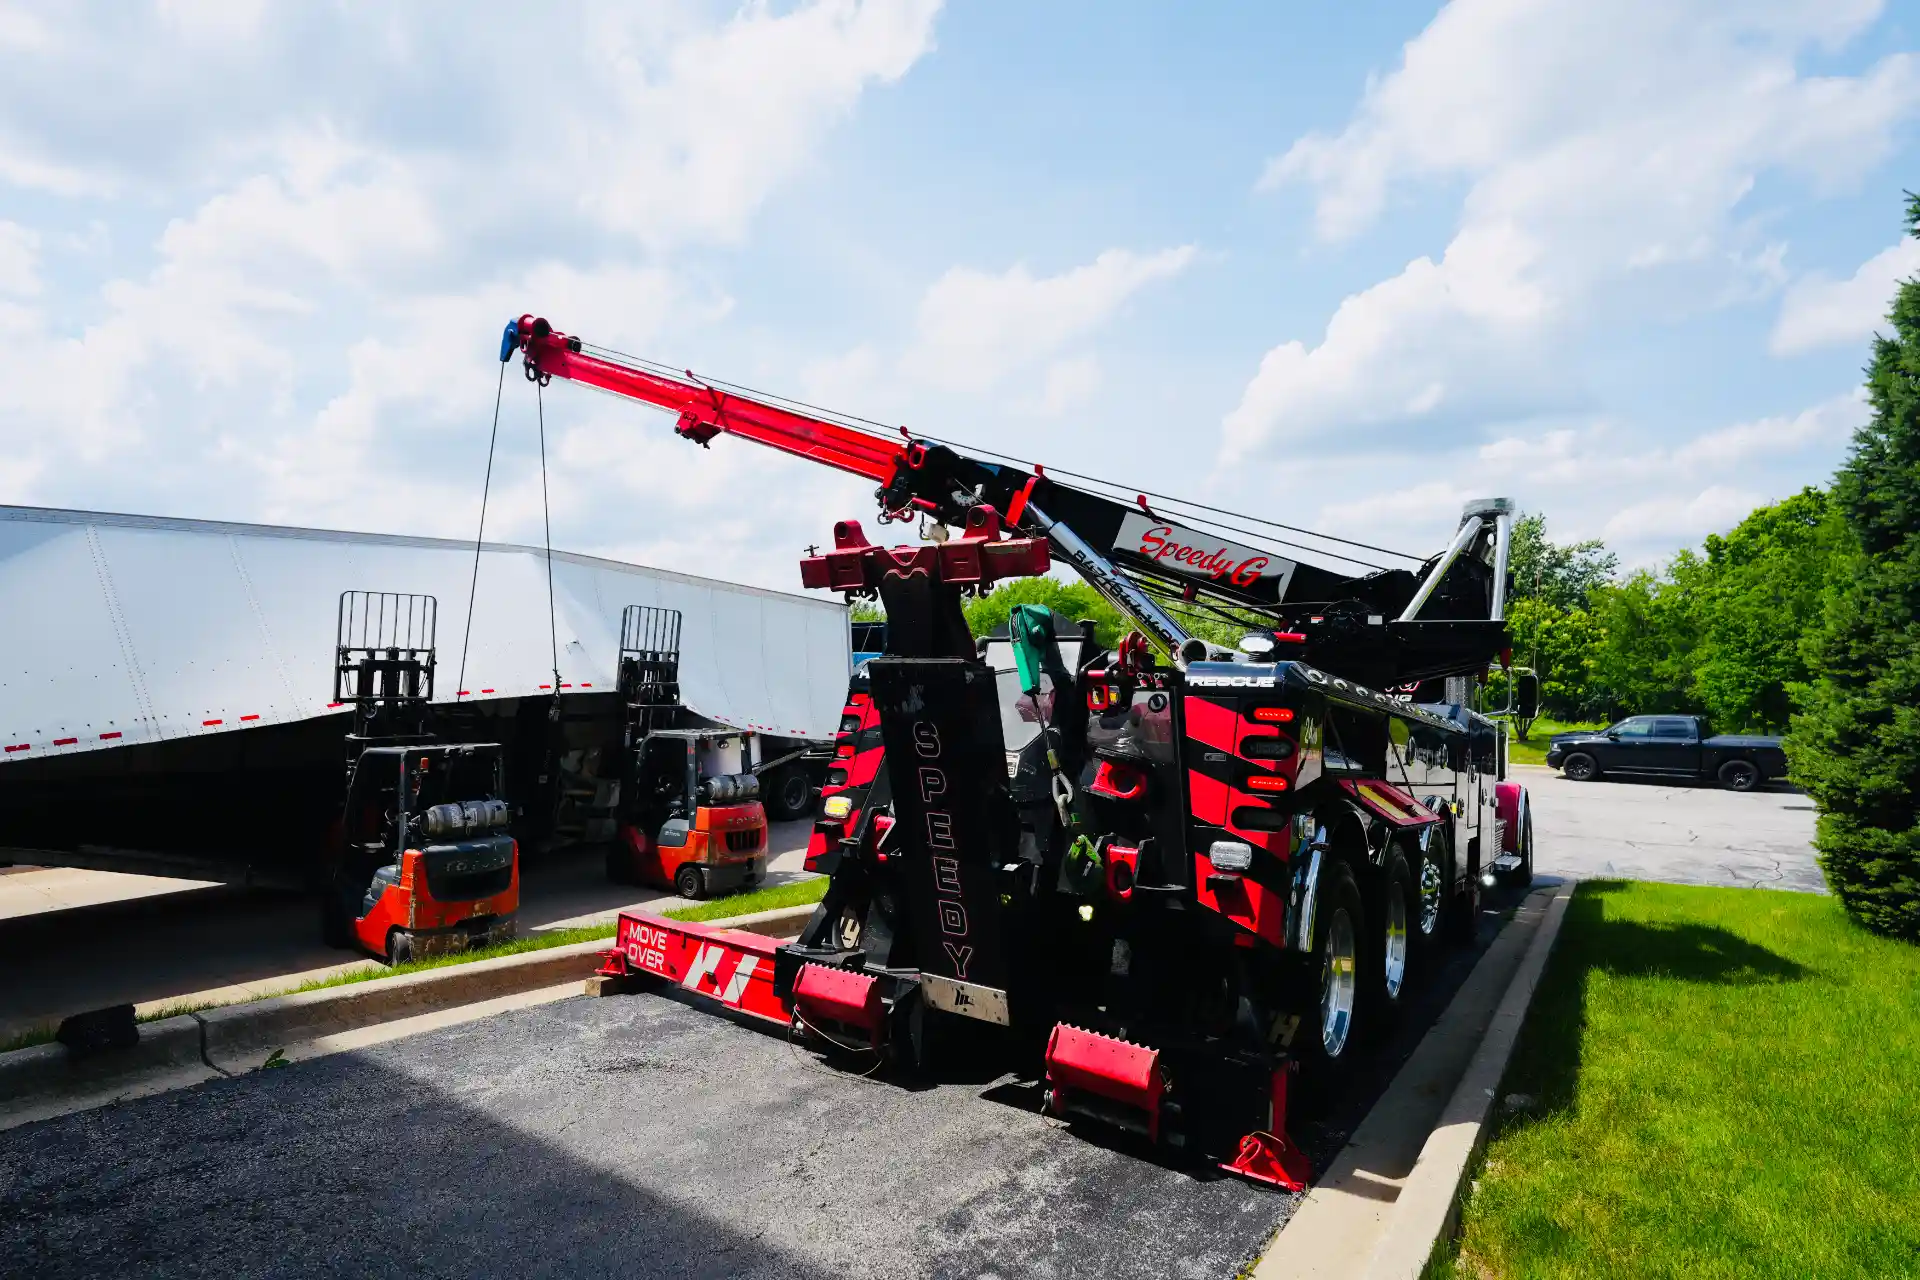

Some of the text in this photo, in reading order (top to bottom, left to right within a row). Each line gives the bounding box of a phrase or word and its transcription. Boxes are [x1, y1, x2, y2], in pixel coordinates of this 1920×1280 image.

[1140, 527, 1269, 588] Speedy G
[1186, 676, 1276, 688] RESCUE
[912, 720, 974, 979] SPEEDY
[629, 921, 668, 951] MOVE
[628, 942, 665, 971] OVER
